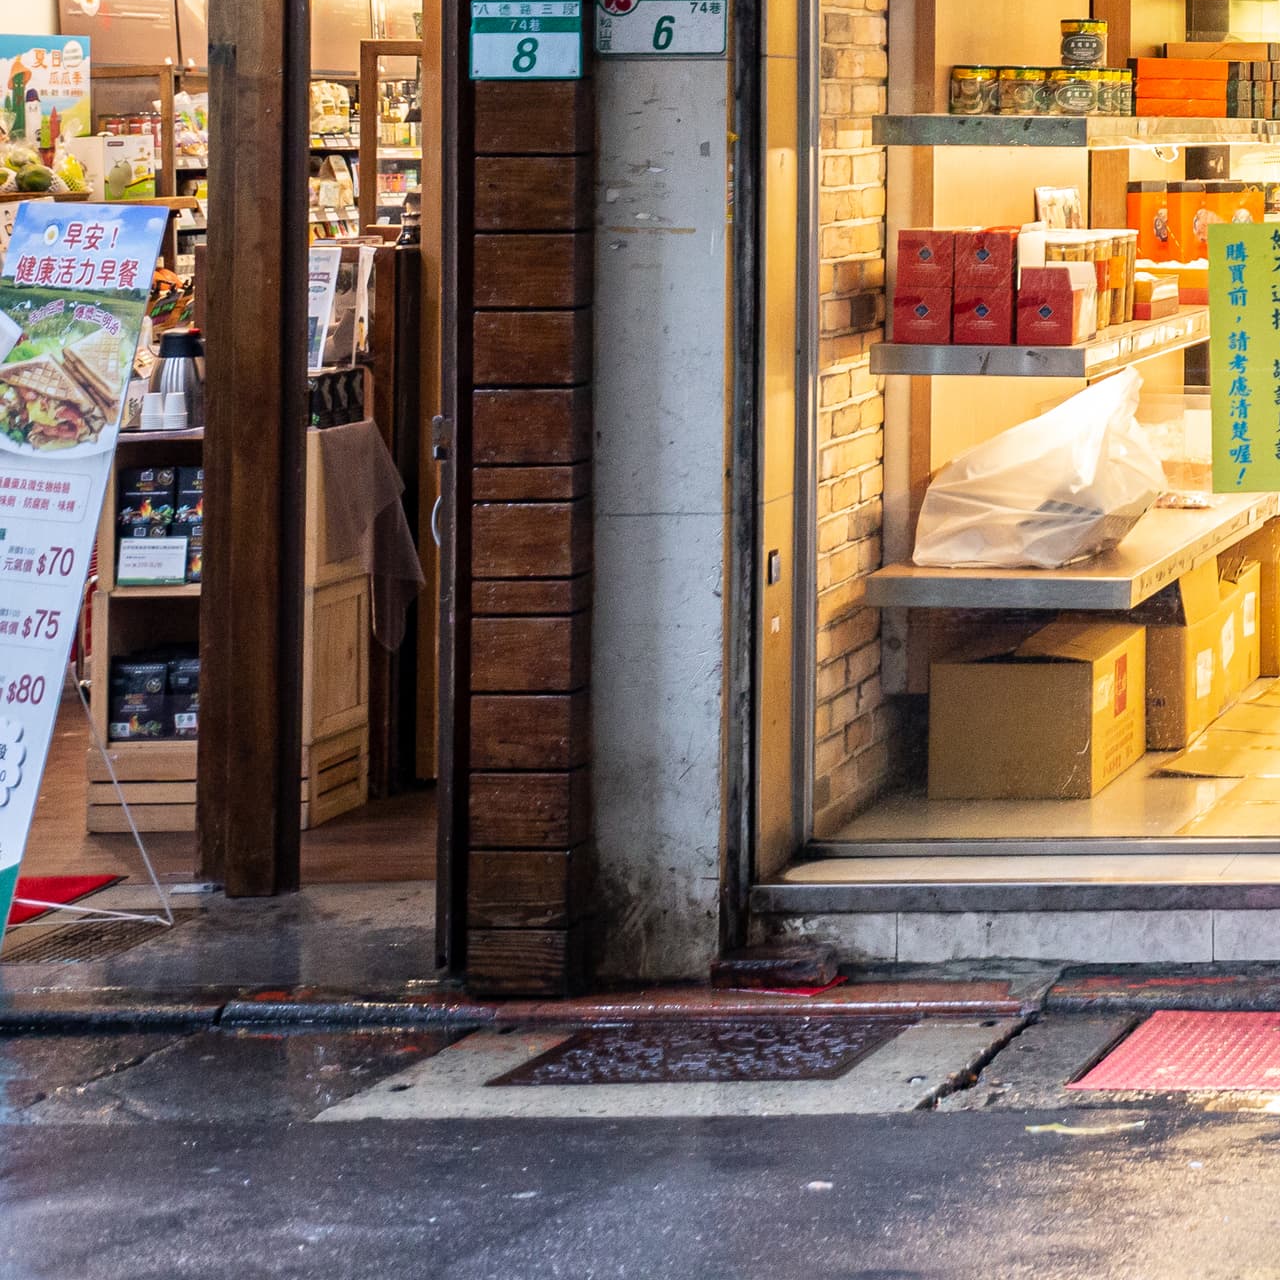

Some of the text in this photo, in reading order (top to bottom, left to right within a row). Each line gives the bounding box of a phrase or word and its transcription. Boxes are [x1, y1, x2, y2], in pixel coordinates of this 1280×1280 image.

[478, 4, 577, 16] 八德路三段
[690, 2, 722, 13] 74巷
[510, 19, 541, 32] 74巷
[652, 15, 675, 50] 6
[512, 37, 538, 72] 8
[15, 256, 140, 287] 健康活力早餐
[37, 547, 74, 576] $70
[22, 609, 61, 640] $75
[7, 674, 45, 705] $80
